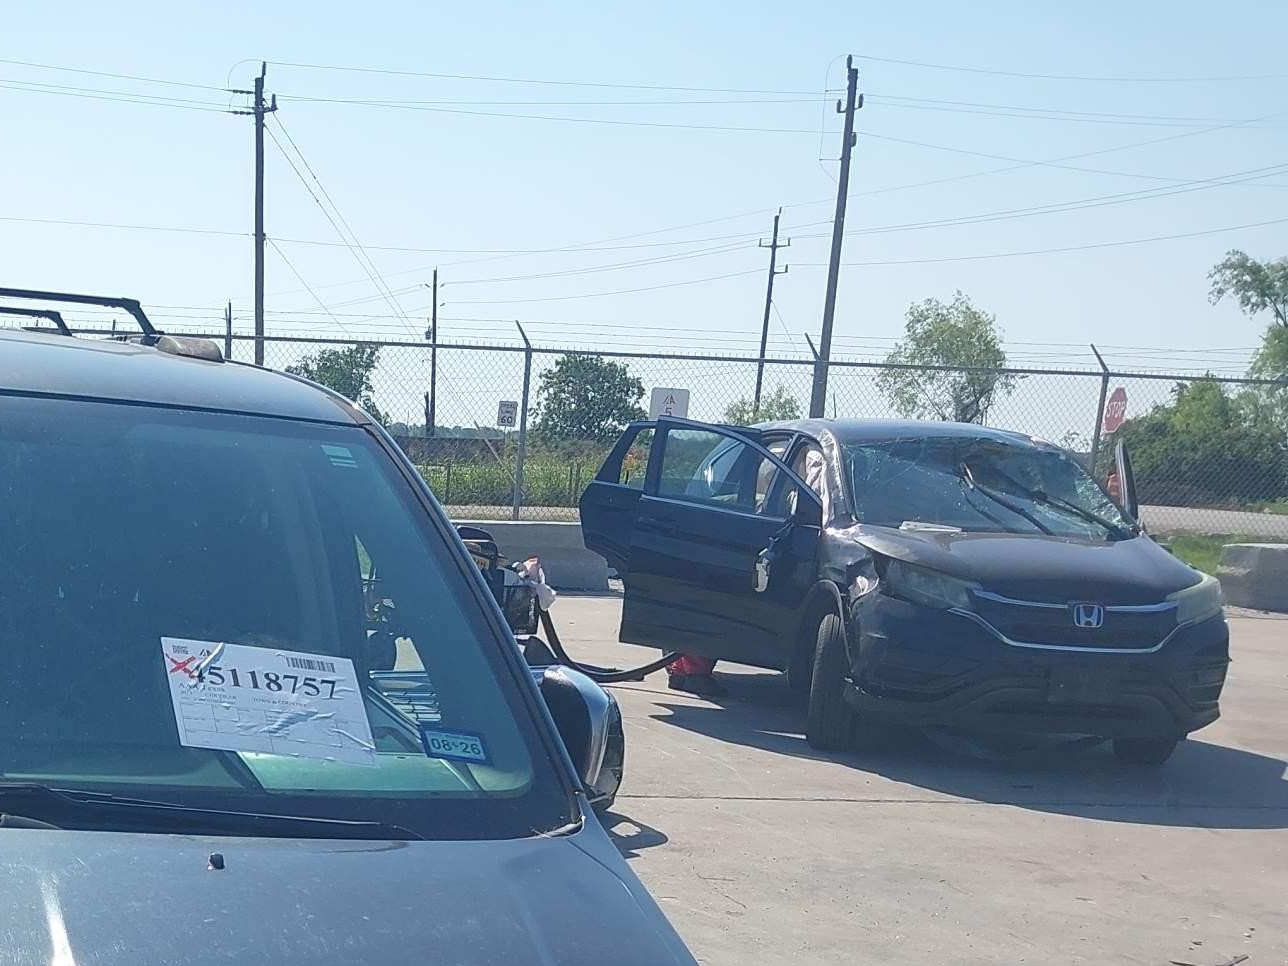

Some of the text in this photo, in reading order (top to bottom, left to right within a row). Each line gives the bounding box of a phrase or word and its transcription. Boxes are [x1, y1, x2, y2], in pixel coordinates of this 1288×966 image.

[1106, 400, 1126, 418] STOP
[500, 416, 513, 424] 60
[191, 662, 337, 700] 45118757
[431, 738, 452, 752] 08
[459, 741, 481, 755] 26
